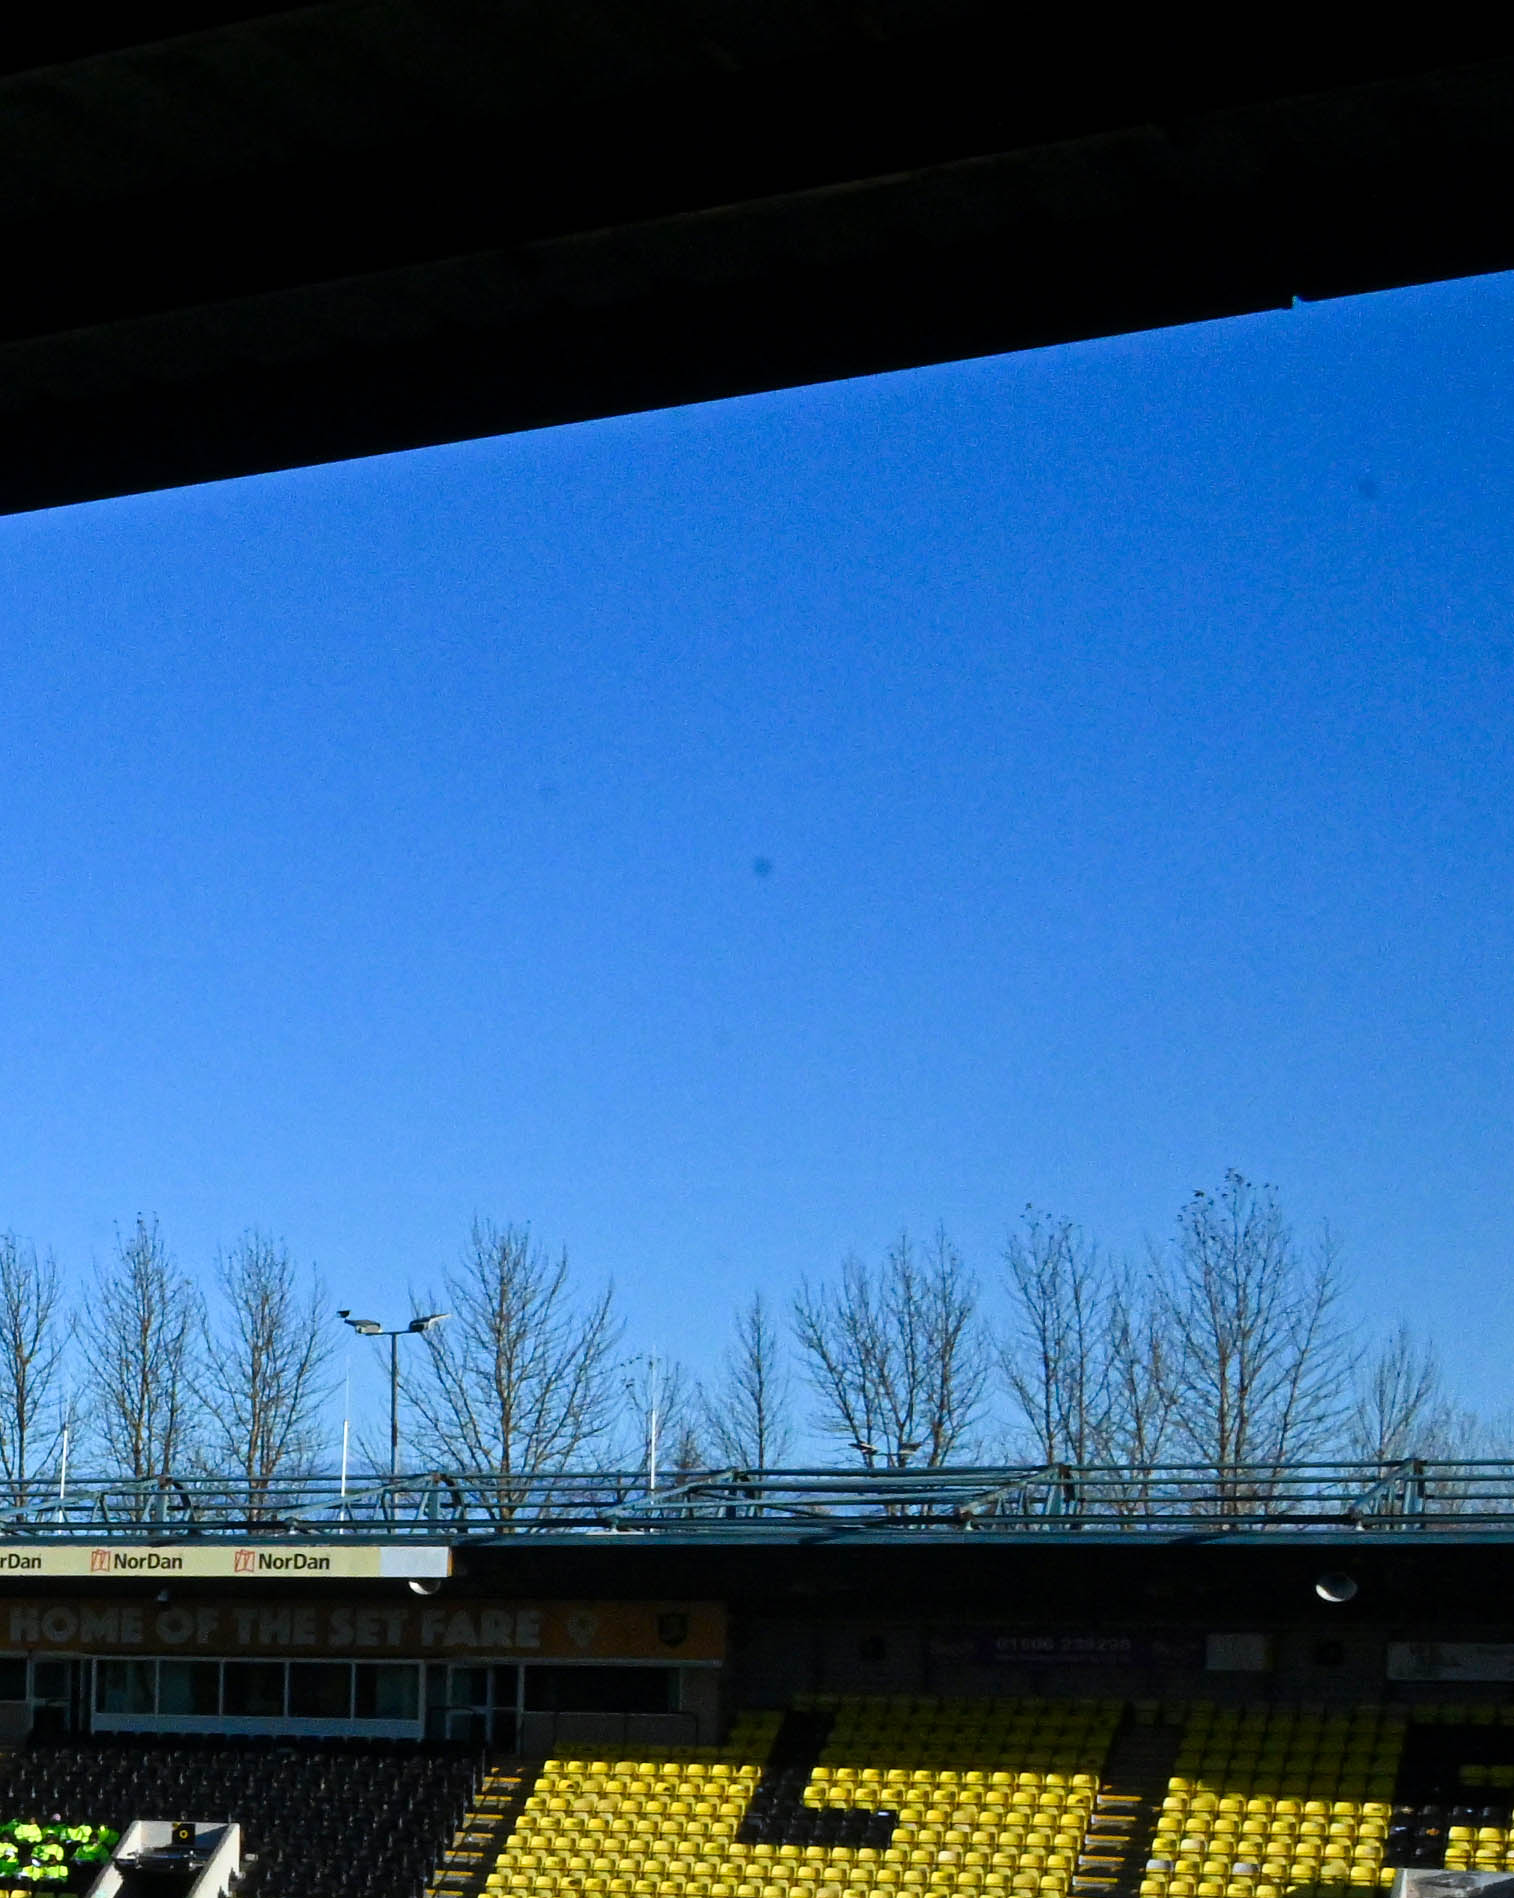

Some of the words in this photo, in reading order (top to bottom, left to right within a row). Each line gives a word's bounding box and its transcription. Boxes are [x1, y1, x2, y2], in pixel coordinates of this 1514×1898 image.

[114, 1553, 183, 1570] NorDan
[258, 1553, 331, 1571] NorDan
[8, 1606, 146, 1645] HOME
[155, 1607, 221, 1645] OF
[234, 1608, 318, 1647] THE
[327, 1610, 408, 1648] SET
[419, 1611, 543, 1650] FARE
